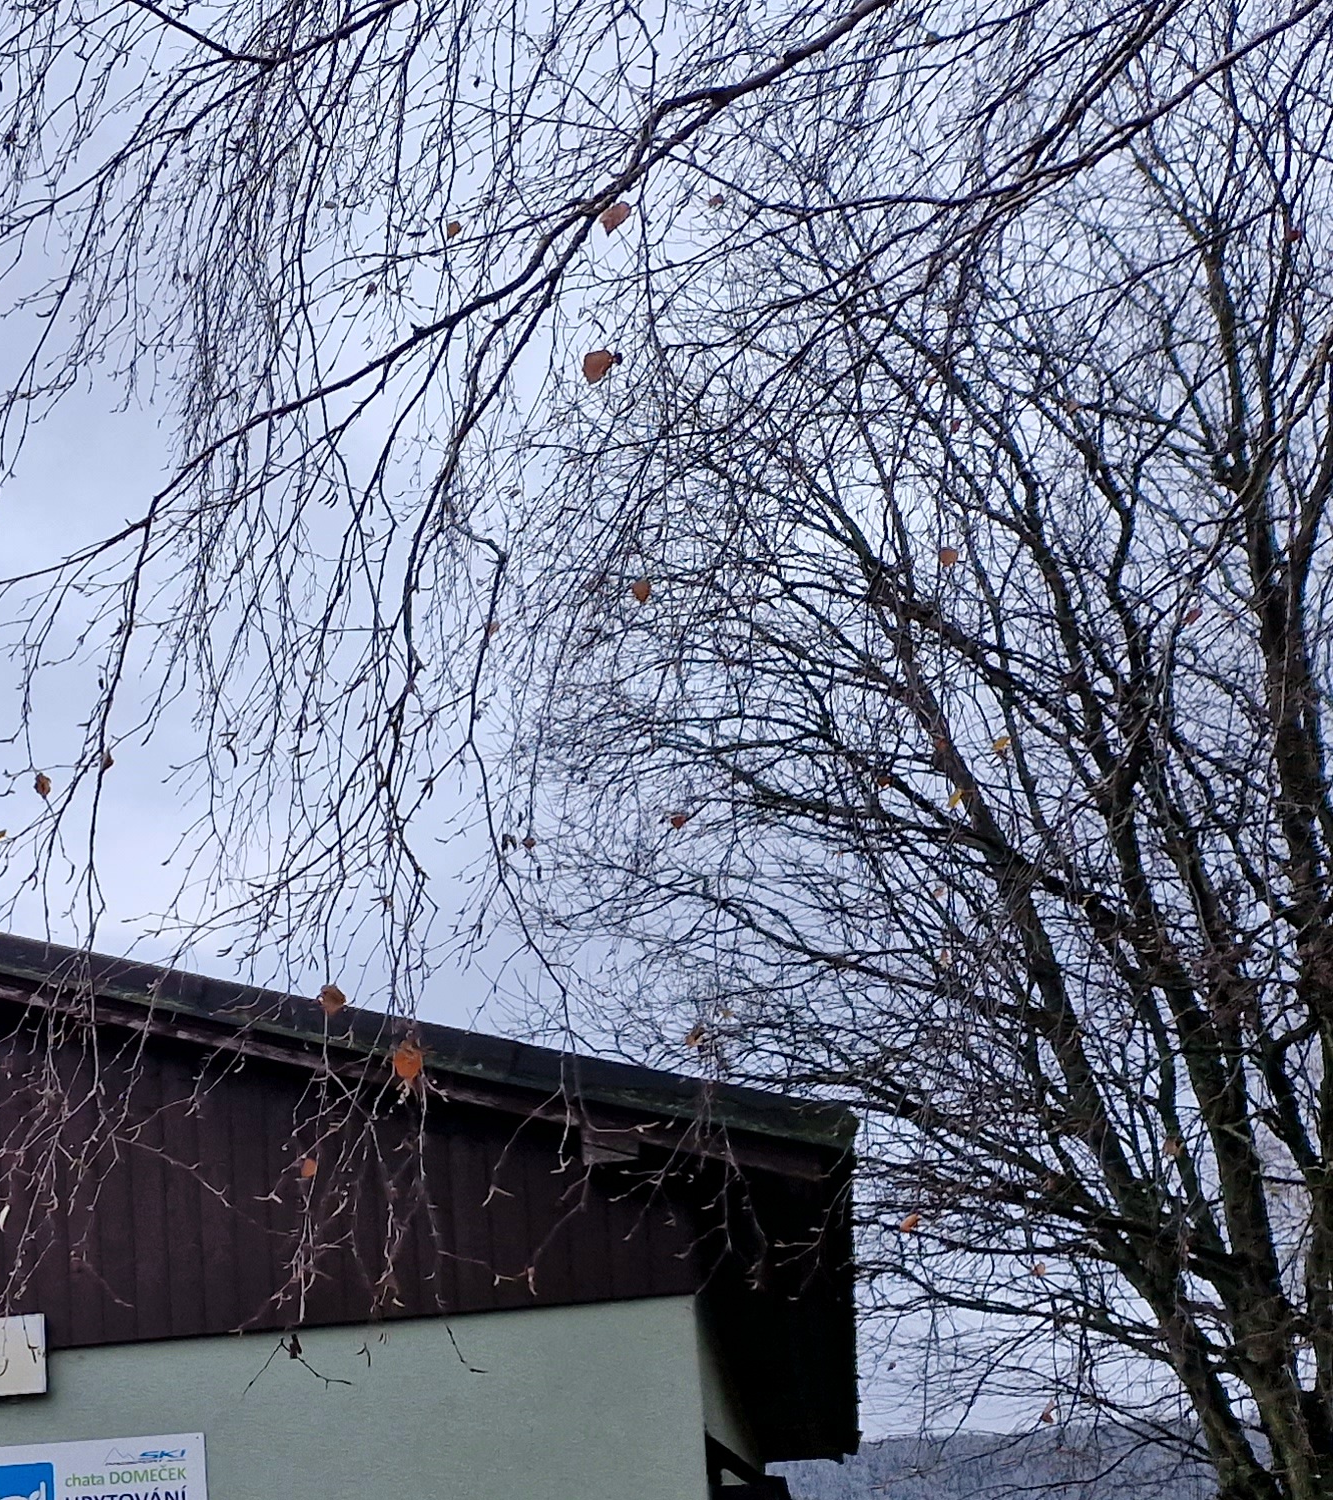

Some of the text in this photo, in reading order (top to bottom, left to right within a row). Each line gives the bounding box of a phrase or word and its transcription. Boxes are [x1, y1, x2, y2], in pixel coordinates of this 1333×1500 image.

[138, 1448, 186, 1459] SKI
[65, 1464, 187, 1487] chata DOMEČEK
